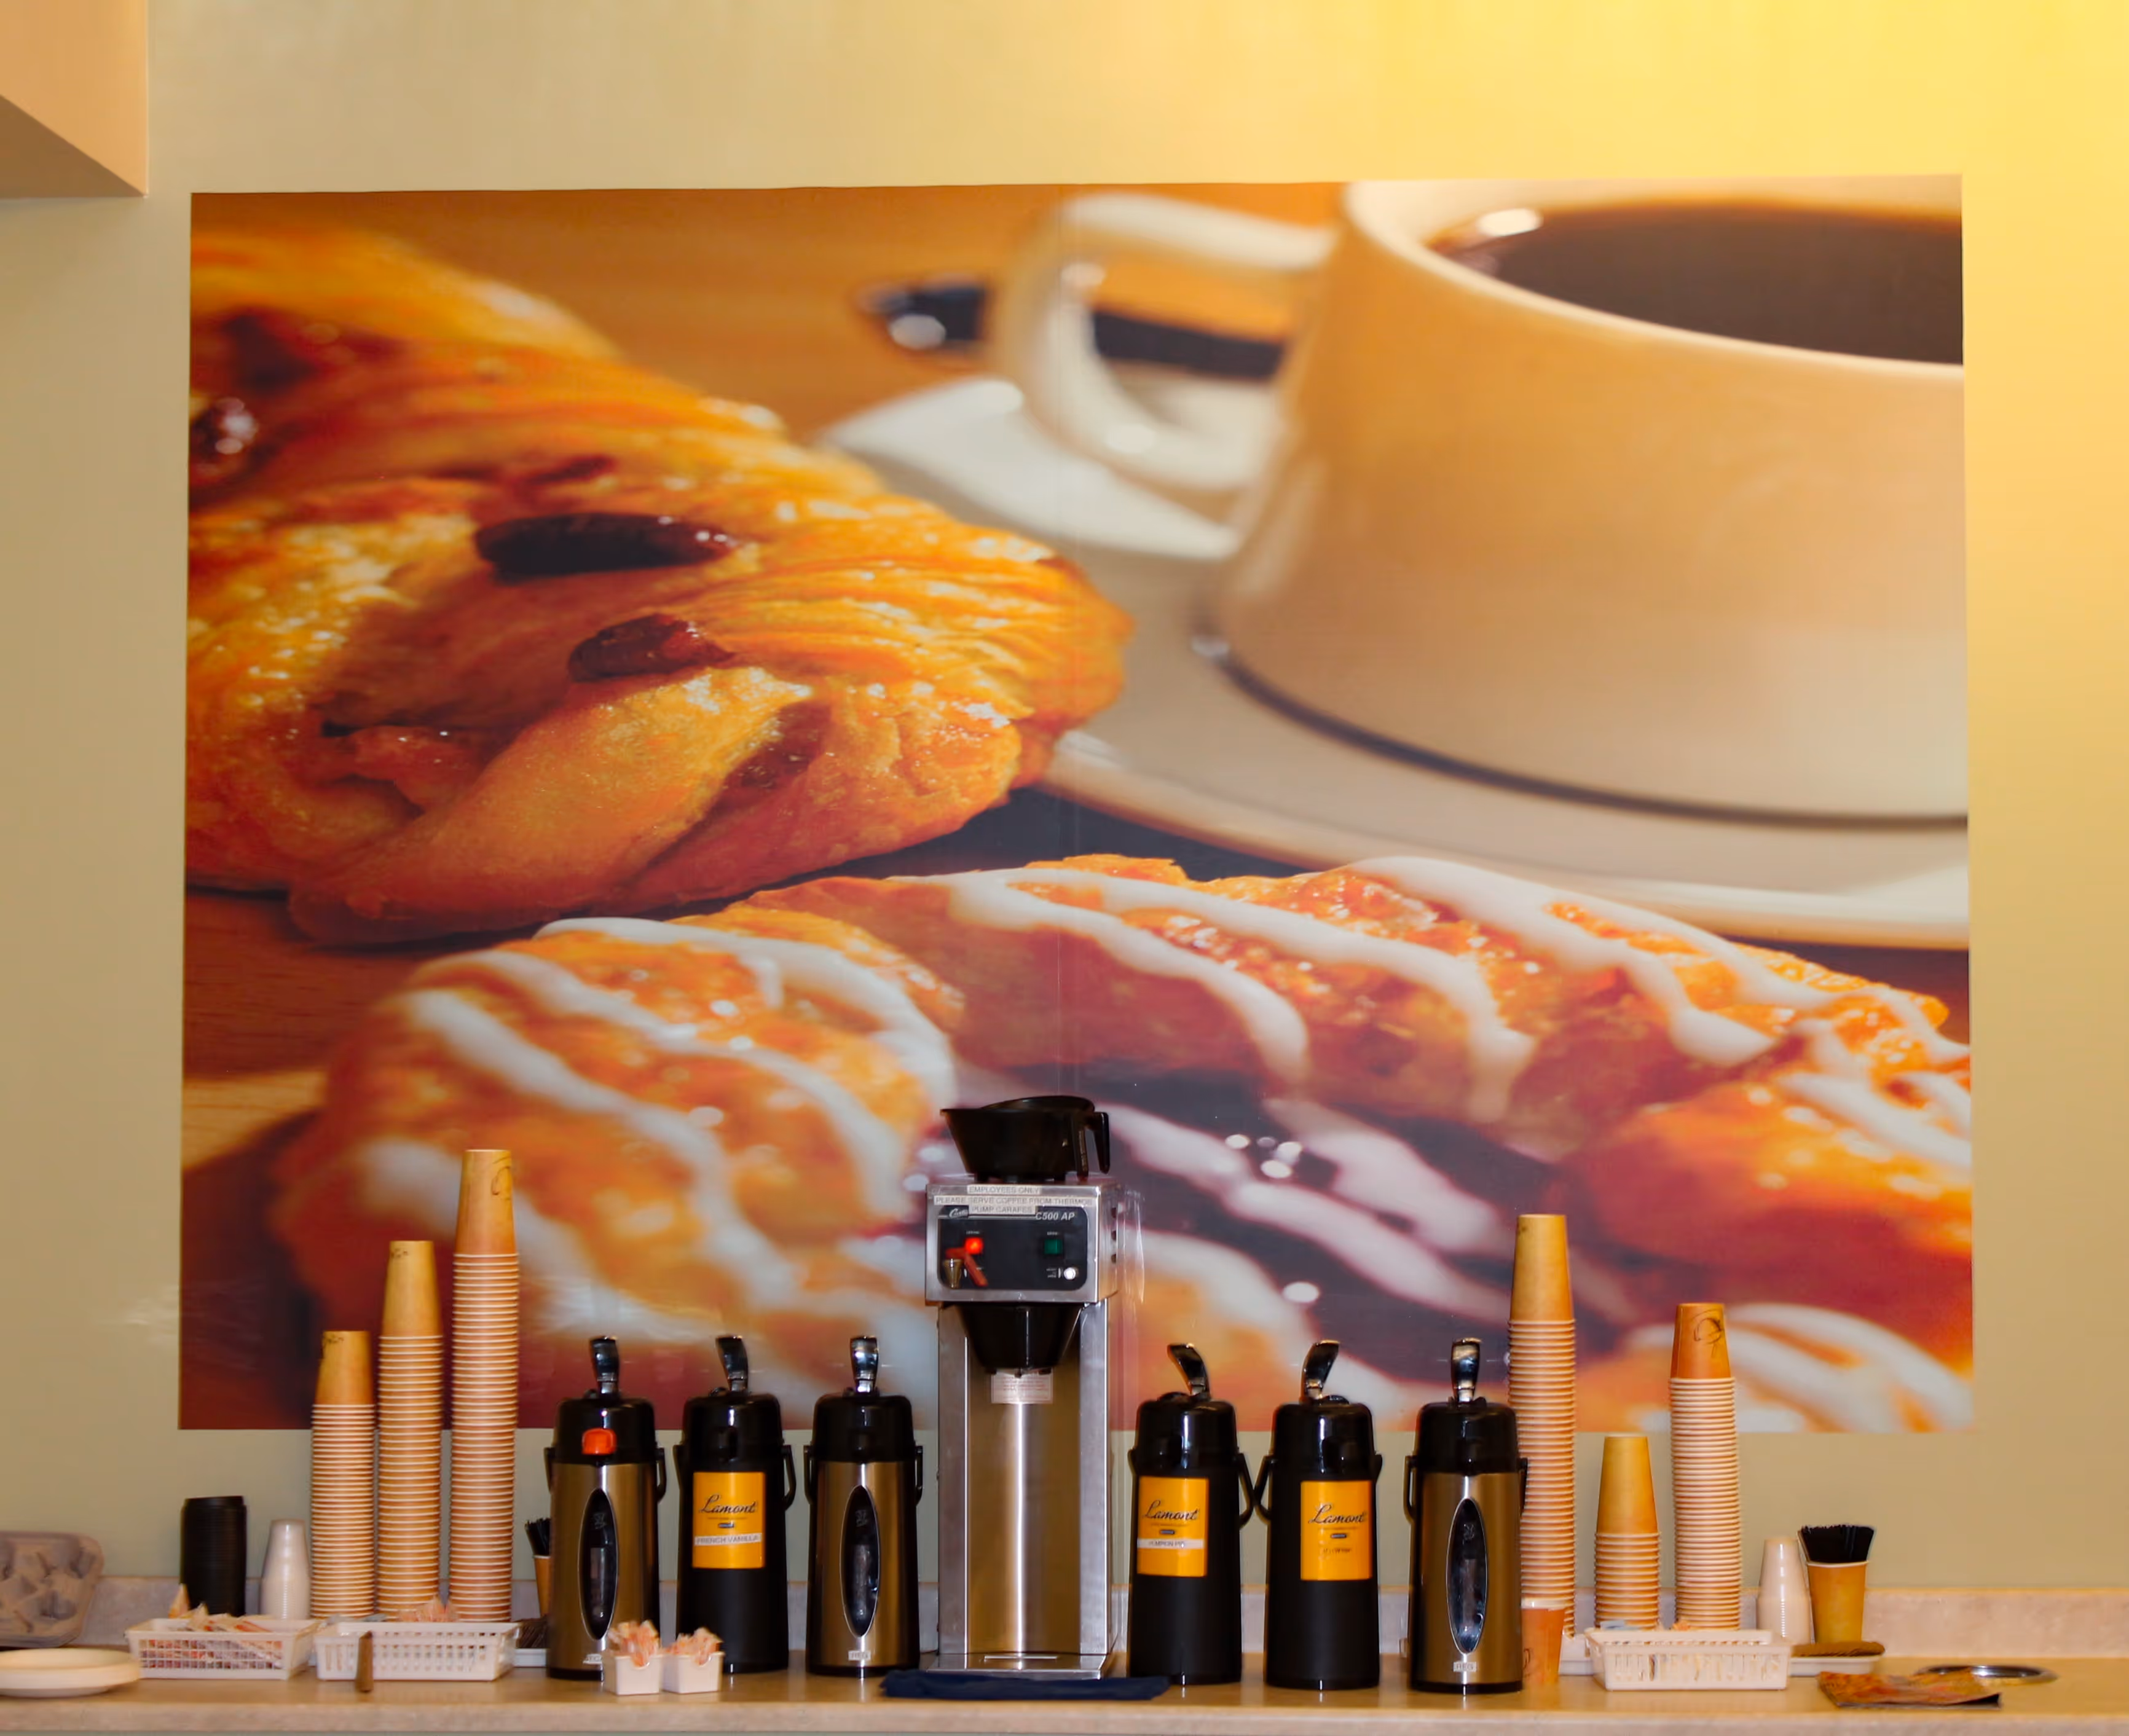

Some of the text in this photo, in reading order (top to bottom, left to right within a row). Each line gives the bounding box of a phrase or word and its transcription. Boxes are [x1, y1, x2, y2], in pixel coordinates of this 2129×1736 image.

[699, 1494, 757, 1514] Lamont
[1142, 1499, 1199, 1520] Lamont
[1308, 1504, 1366, 1524] Lamont
[728, 1534, 758, 1543] VANILLA
[1457, 1662, 1473, 1671] REG
